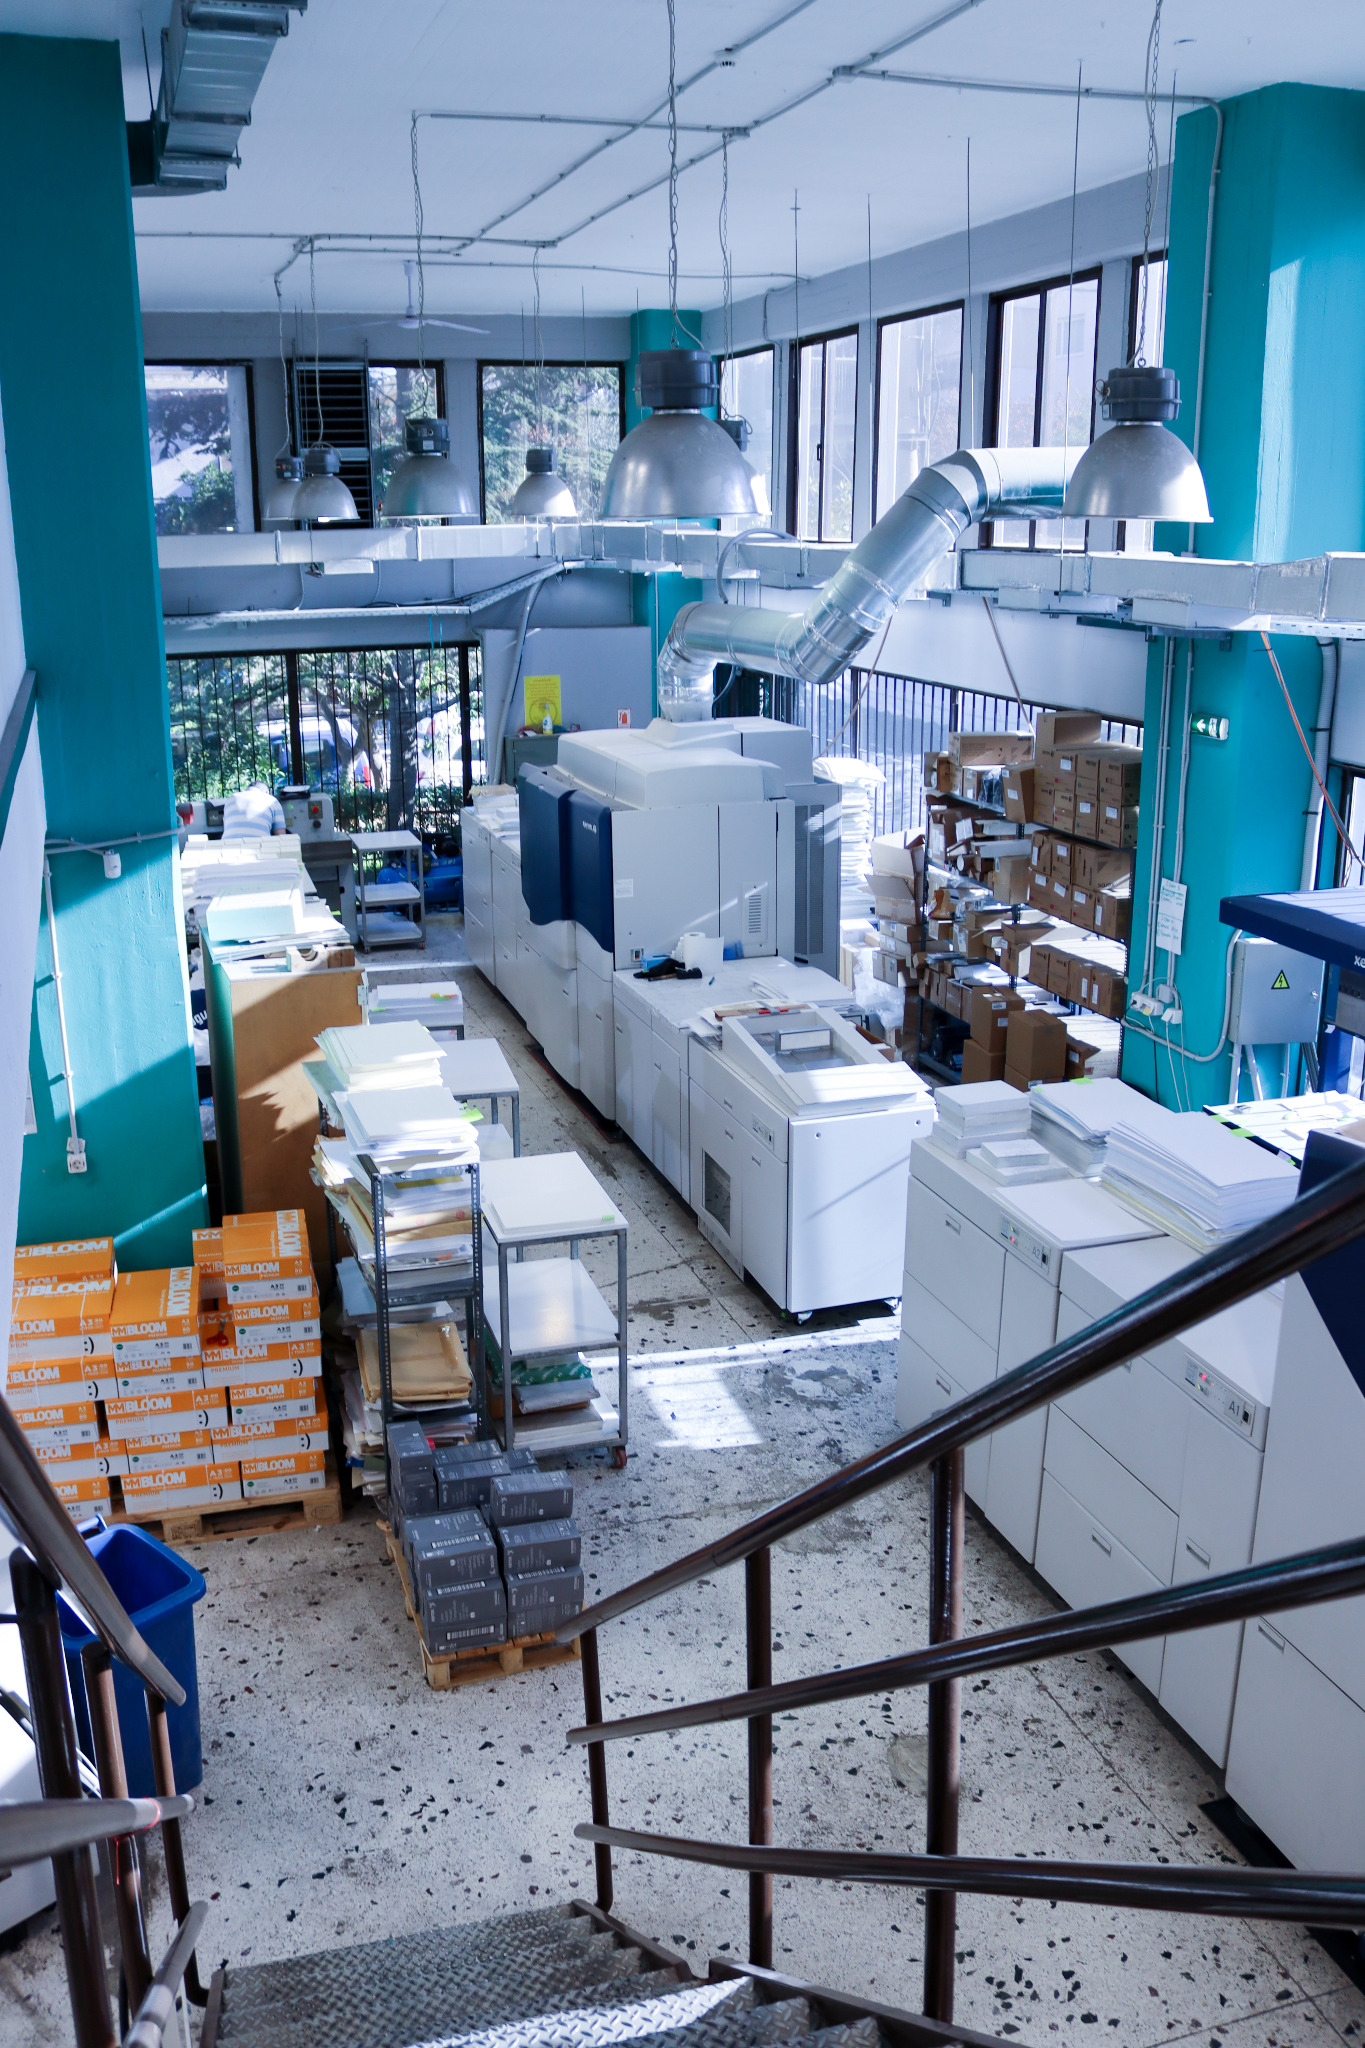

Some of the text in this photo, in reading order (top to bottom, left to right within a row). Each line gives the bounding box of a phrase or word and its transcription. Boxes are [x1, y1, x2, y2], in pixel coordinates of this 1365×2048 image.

[32, 1240, 108, 1256] BLOOM
[225, 1264, 240, 1276] MM
[240, 1262, 279, 1275] BLOOM
[30, 1280, 111, 1297] BLOOM
[234, 1308, 250, 1320] MM
[250, 1304, 289, 1318] BLOOM
[127, 1321, 167, 1335] BLOOM
[202, 1350, 220, 1362] MM
[221, 1344, 268, 1360] BLOOM
[132, 1358, 171, 1370] BLOOM
[13, 1366, 60, 1384] BLOOM
[85, 1363, 98, 1372] A3
[231, 1389, 246, 1400] MM
[246, 1384, 285, 1398] BLOOM
[106, 1402, 125, 1415] MM
[125, 1396, 172, 1412] BLOOM
[1229, 1401, 1240, 1416] A1
[24, 1408, 64, 1422] BLOOM
[211, 1427, 229, 1439] MM
[229, 1421, 275, 1436] BLOOM
[141, 1433, 180, 1446] BLOOM
[35, 1444, 71, 1459] LOOM
[242, 1463, 257, 1474] MM
[257, 1458, 296, 1471] BLOOM
[121, 1477, 140, 1490] MM
[140, 1471, 187, 1488] BLOOM
